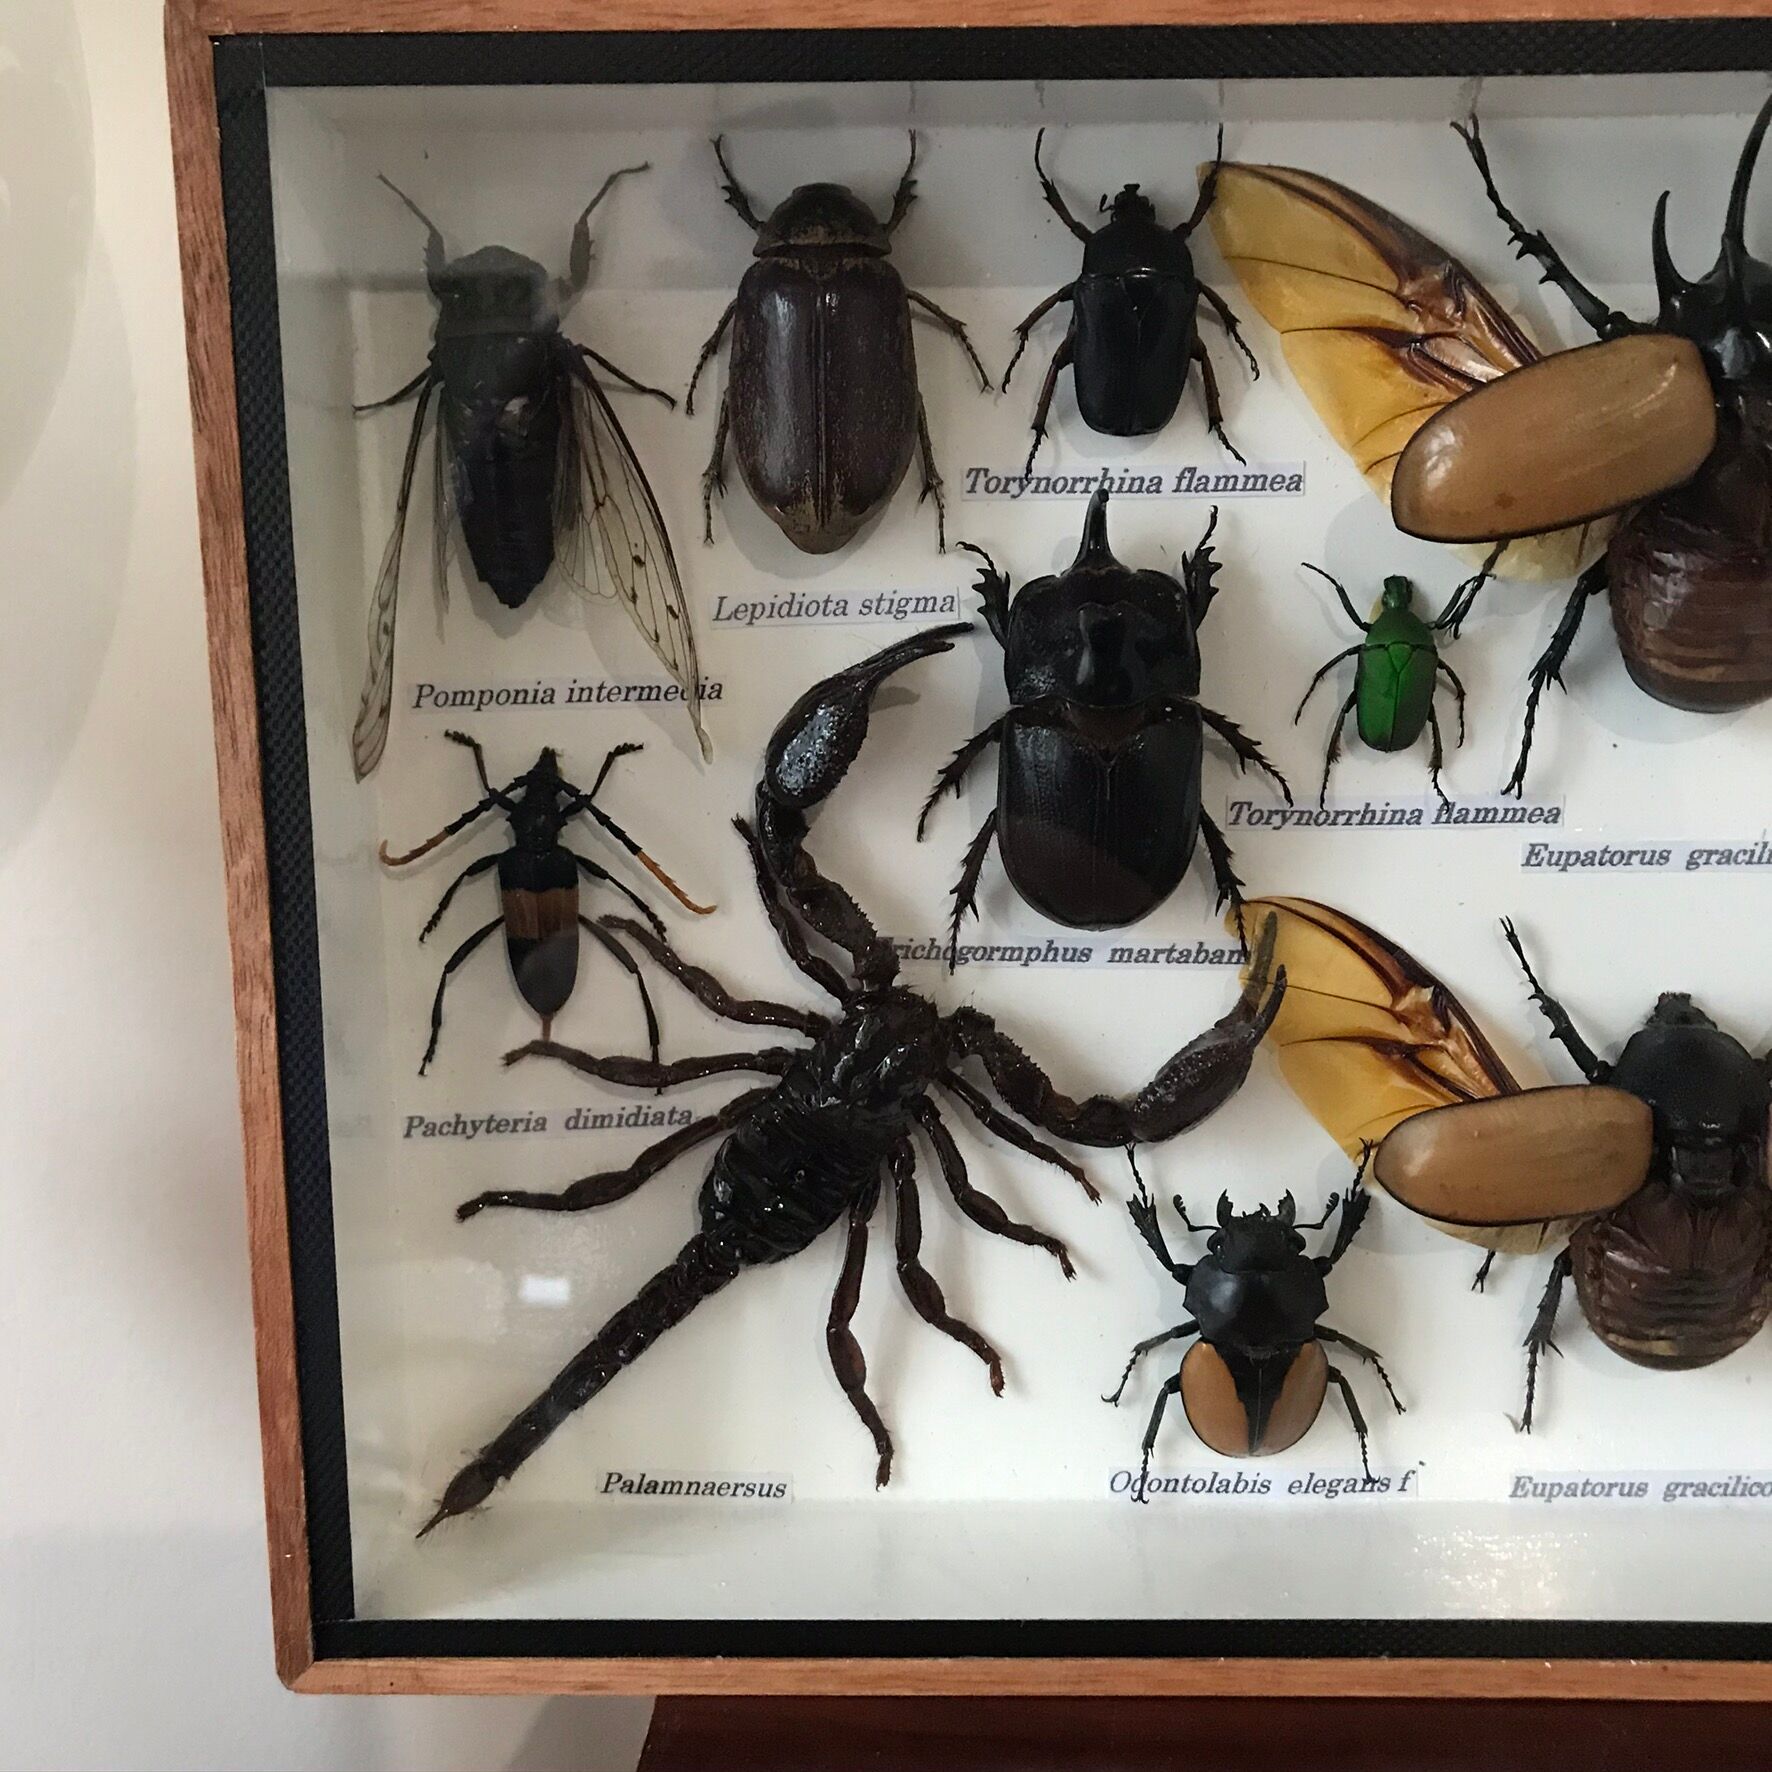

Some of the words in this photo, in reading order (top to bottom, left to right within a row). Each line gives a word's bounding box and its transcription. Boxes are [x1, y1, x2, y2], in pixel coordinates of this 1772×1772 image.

[1171, 464, 1304, 492] flammea
[712, 592, 848, 624] Lepidiota
[858, 590, 955, 619] stigma
[412, 684, 556, 712] Pomponia
[1228, 802, 1422, 830] Torynorrhina
[1522, 843, 1672, 872] Eupatorus
[886, 937, 1092, 966] richogormphus
[403, 1113, 547, 1140] Pachyteria
[564, 1106, 692, 1131] dimidiata
[600, 1472, 787, 1498] Palamnaersus
[1509, 1475, 1649, 1502] Eupatorus
